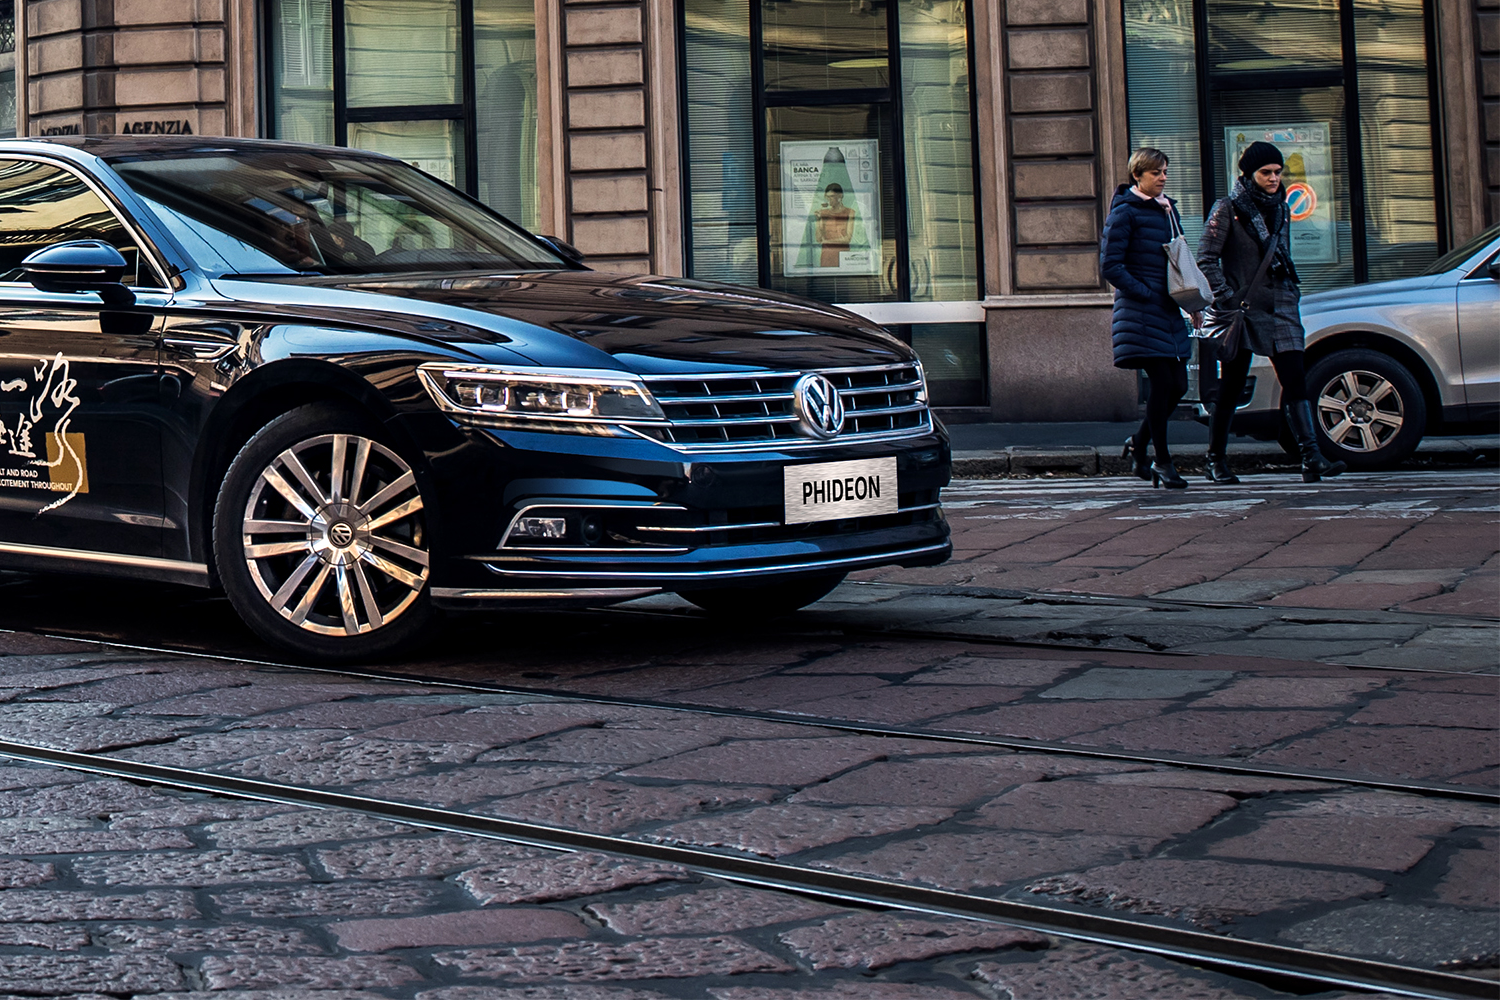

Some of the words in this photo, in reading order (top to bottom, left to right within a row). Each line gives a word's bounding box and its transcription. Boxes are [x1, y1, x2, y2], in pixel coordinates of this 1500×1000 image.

[122, 119, 193, 135] AGENZIA
[6, 468, 19, 477] AND
[20, 469, 39, 478] ROAD
[30, 480, 74, 491] THROUGHOUT
[802, 475, 881, 505] PHIDEON
